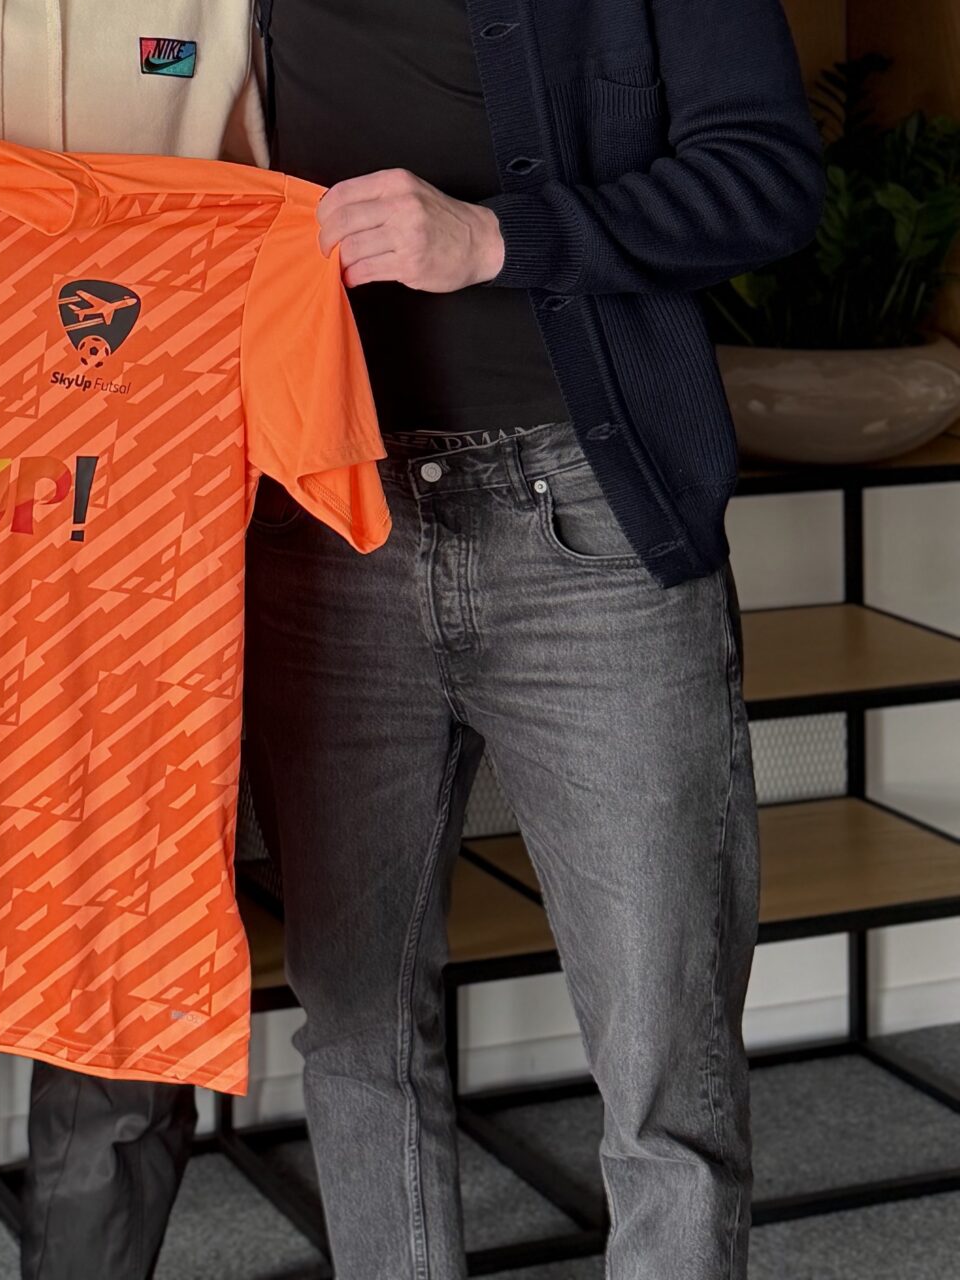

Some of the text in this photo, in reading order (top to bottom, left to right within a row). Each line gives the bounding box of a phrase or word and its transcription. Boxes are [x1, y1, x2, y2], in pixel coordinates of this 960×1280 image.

[151, 38, 186, 60] NIKE
[50, 371, 132, 395] SkyUp Futsal
